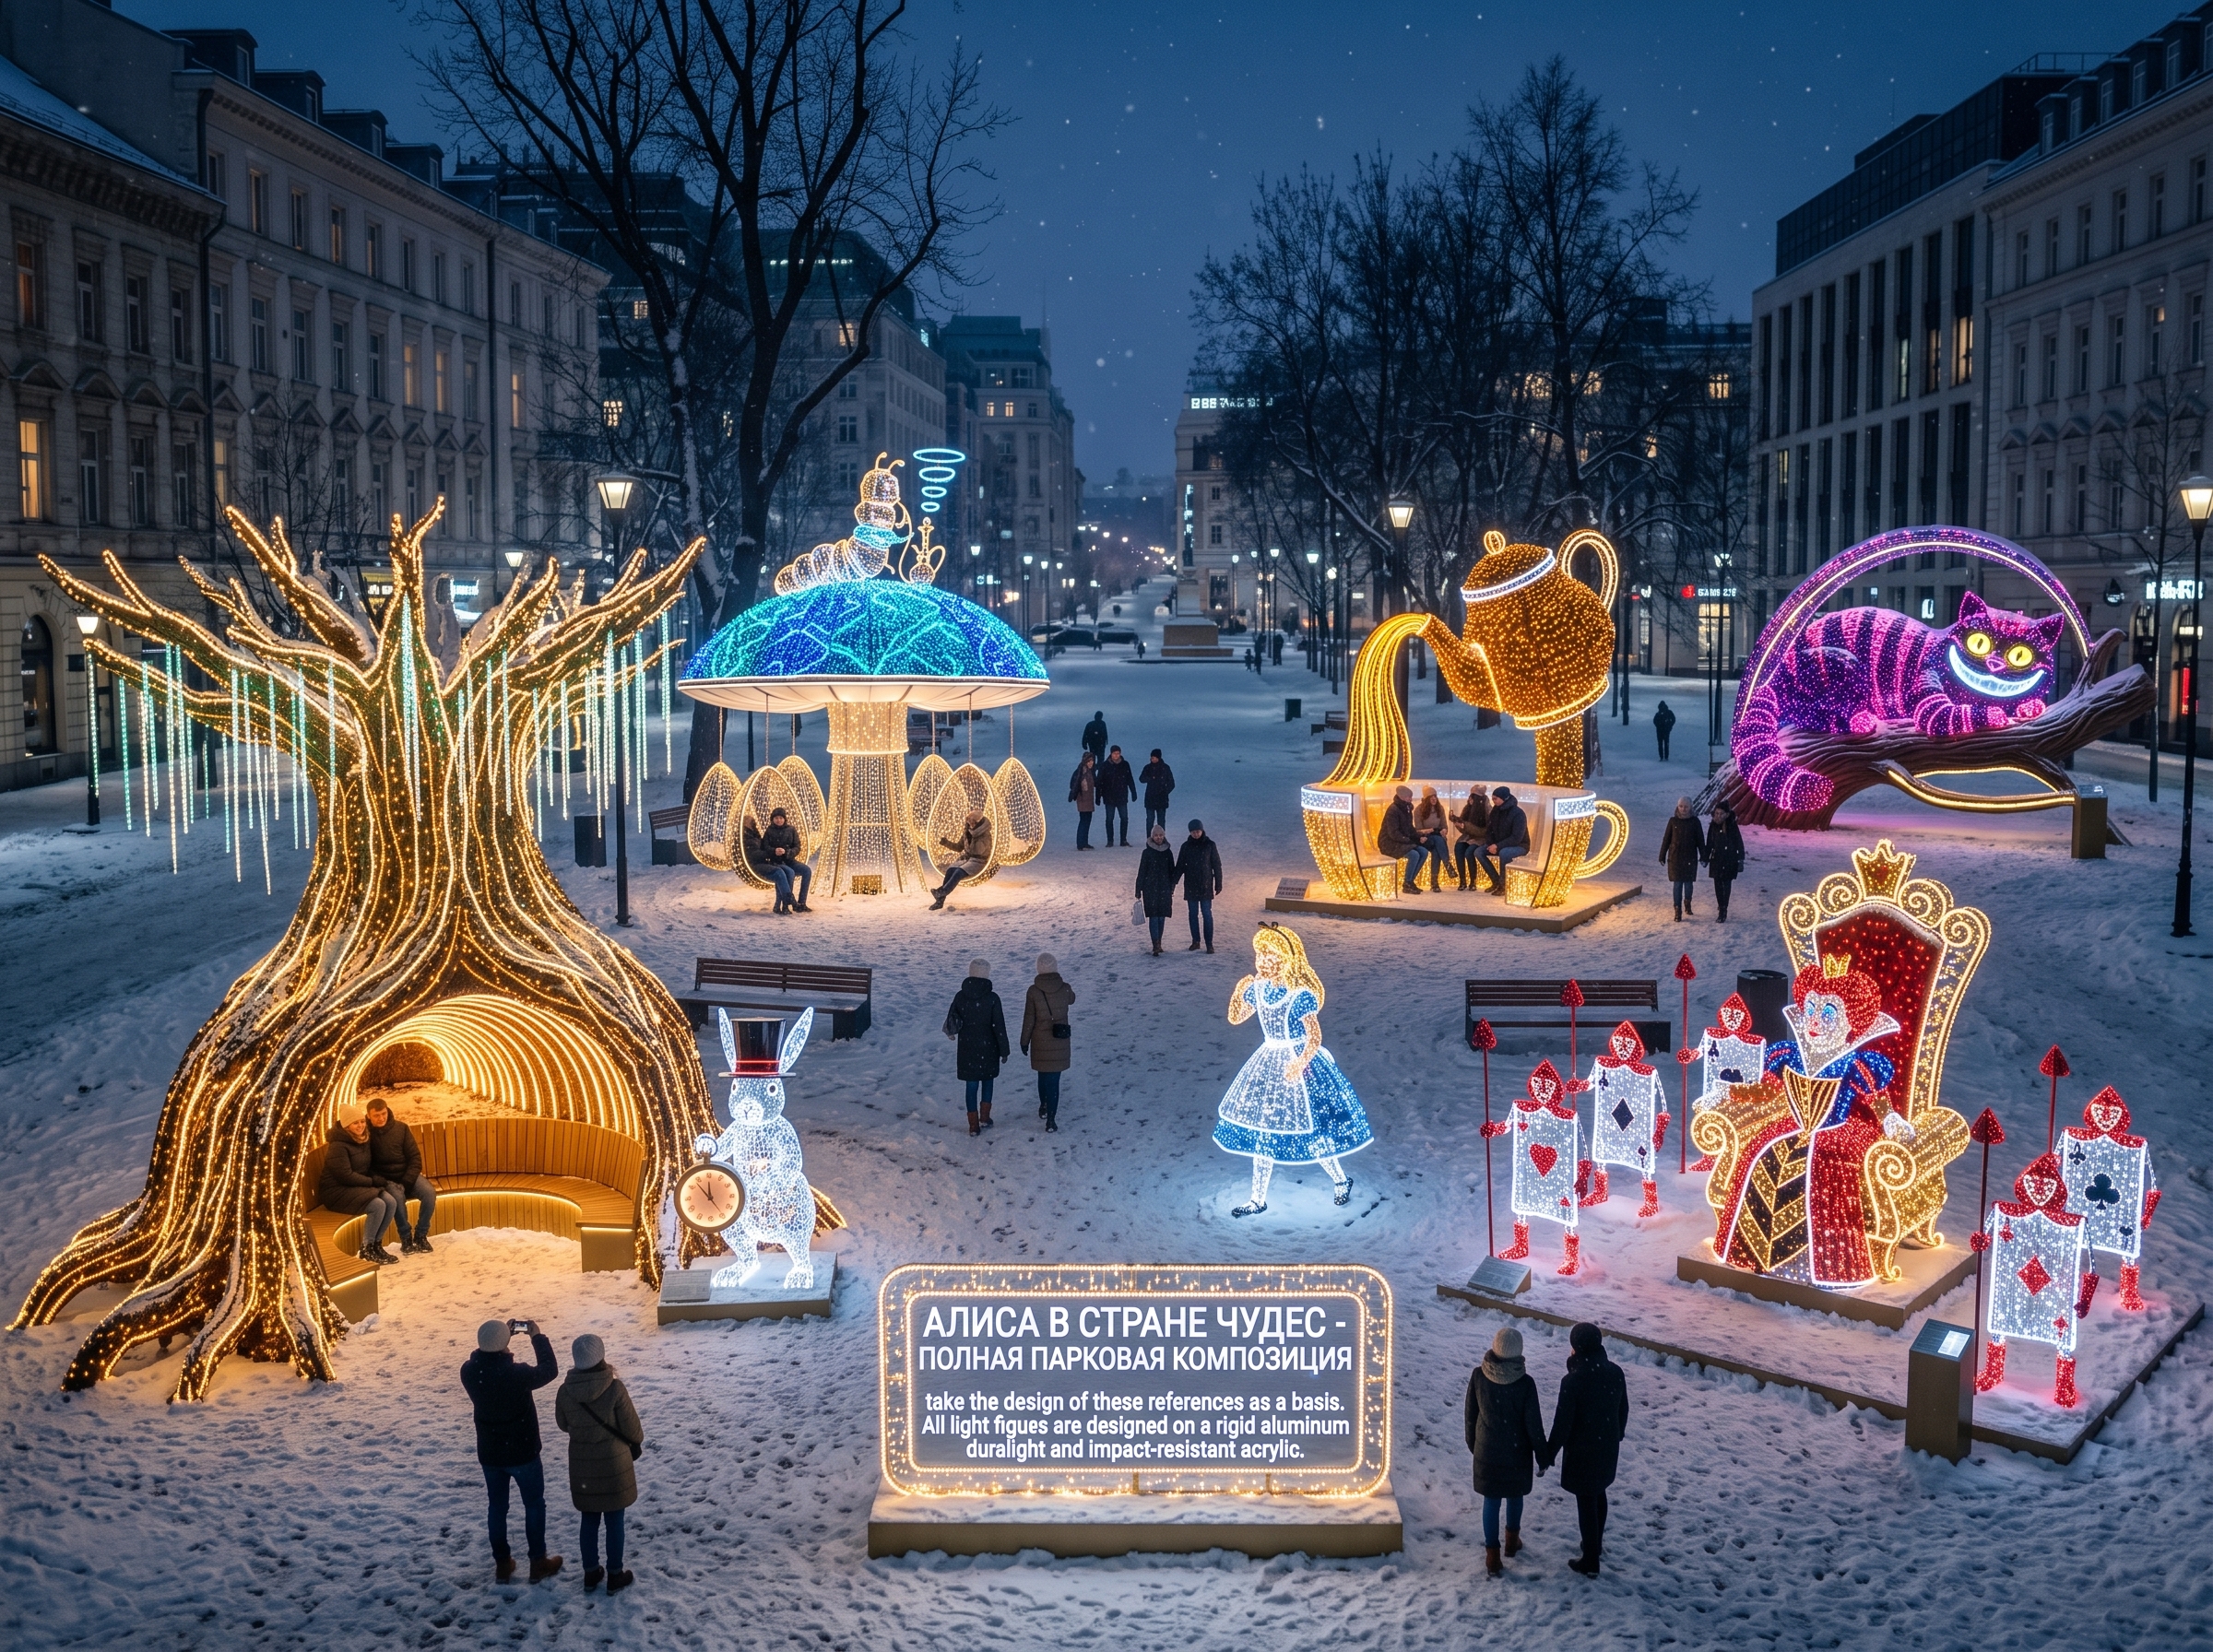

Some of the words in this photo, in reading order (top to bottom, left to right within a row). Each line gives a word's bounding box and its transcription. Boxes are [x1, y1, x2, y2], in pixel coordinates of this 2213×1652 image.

[922, 1306, 1041, 1338] АЛИСА
[1049, 1306, 1070, 1338] В
[1079, 1305, 1207, 1338] СТРАНЕ
[1216, 1305, 1326, 1344] ЧУДЕС
[918, 1346, 1023, 1371] ПОЛНАЯ
[1031, 1346, 1165, 1371] ПАРКОВАЯ
[1173, 1346, 1352, 1375] КОМПОЗИЦИЯ
[925, 1391, 964, 1411] take
[969, 1391, 999, 1411] the
[1003, 1391, 1063, 1415] design
[1069, 1391, 1089, 1411] of
[1093, 1391, 1143, 1411] these
[1148, 1391, 1244, 1411] references
[1249, 1396, 1271, 1411] as
[1275, 1396, 1286, 1411] a
[1292, 1391, 1345, 1411] basis.
[921, 1415, 945, 1434] All
[950, 1414, 989, 1439] light
[994, 1414, 1048, 1439] figues
[1053, 1420, 1082, 1434] are
[1086, 1414, 1167, 1439] designed
[1172, 1420, 1195, 1434] on
[1200, 1420, 1211, 1434] a
[1216, 1414, 1255, 1439] rigid
[1260, 1414, 1350, 1435] aluminum
[966, 1438, 1046, 1463] duralight
[1050, 1438, 1083, 1458] and
[1088, 1439, 1236, 1463] impact-resistant
[1240, 1438, 1305, 1463] acrylic.
